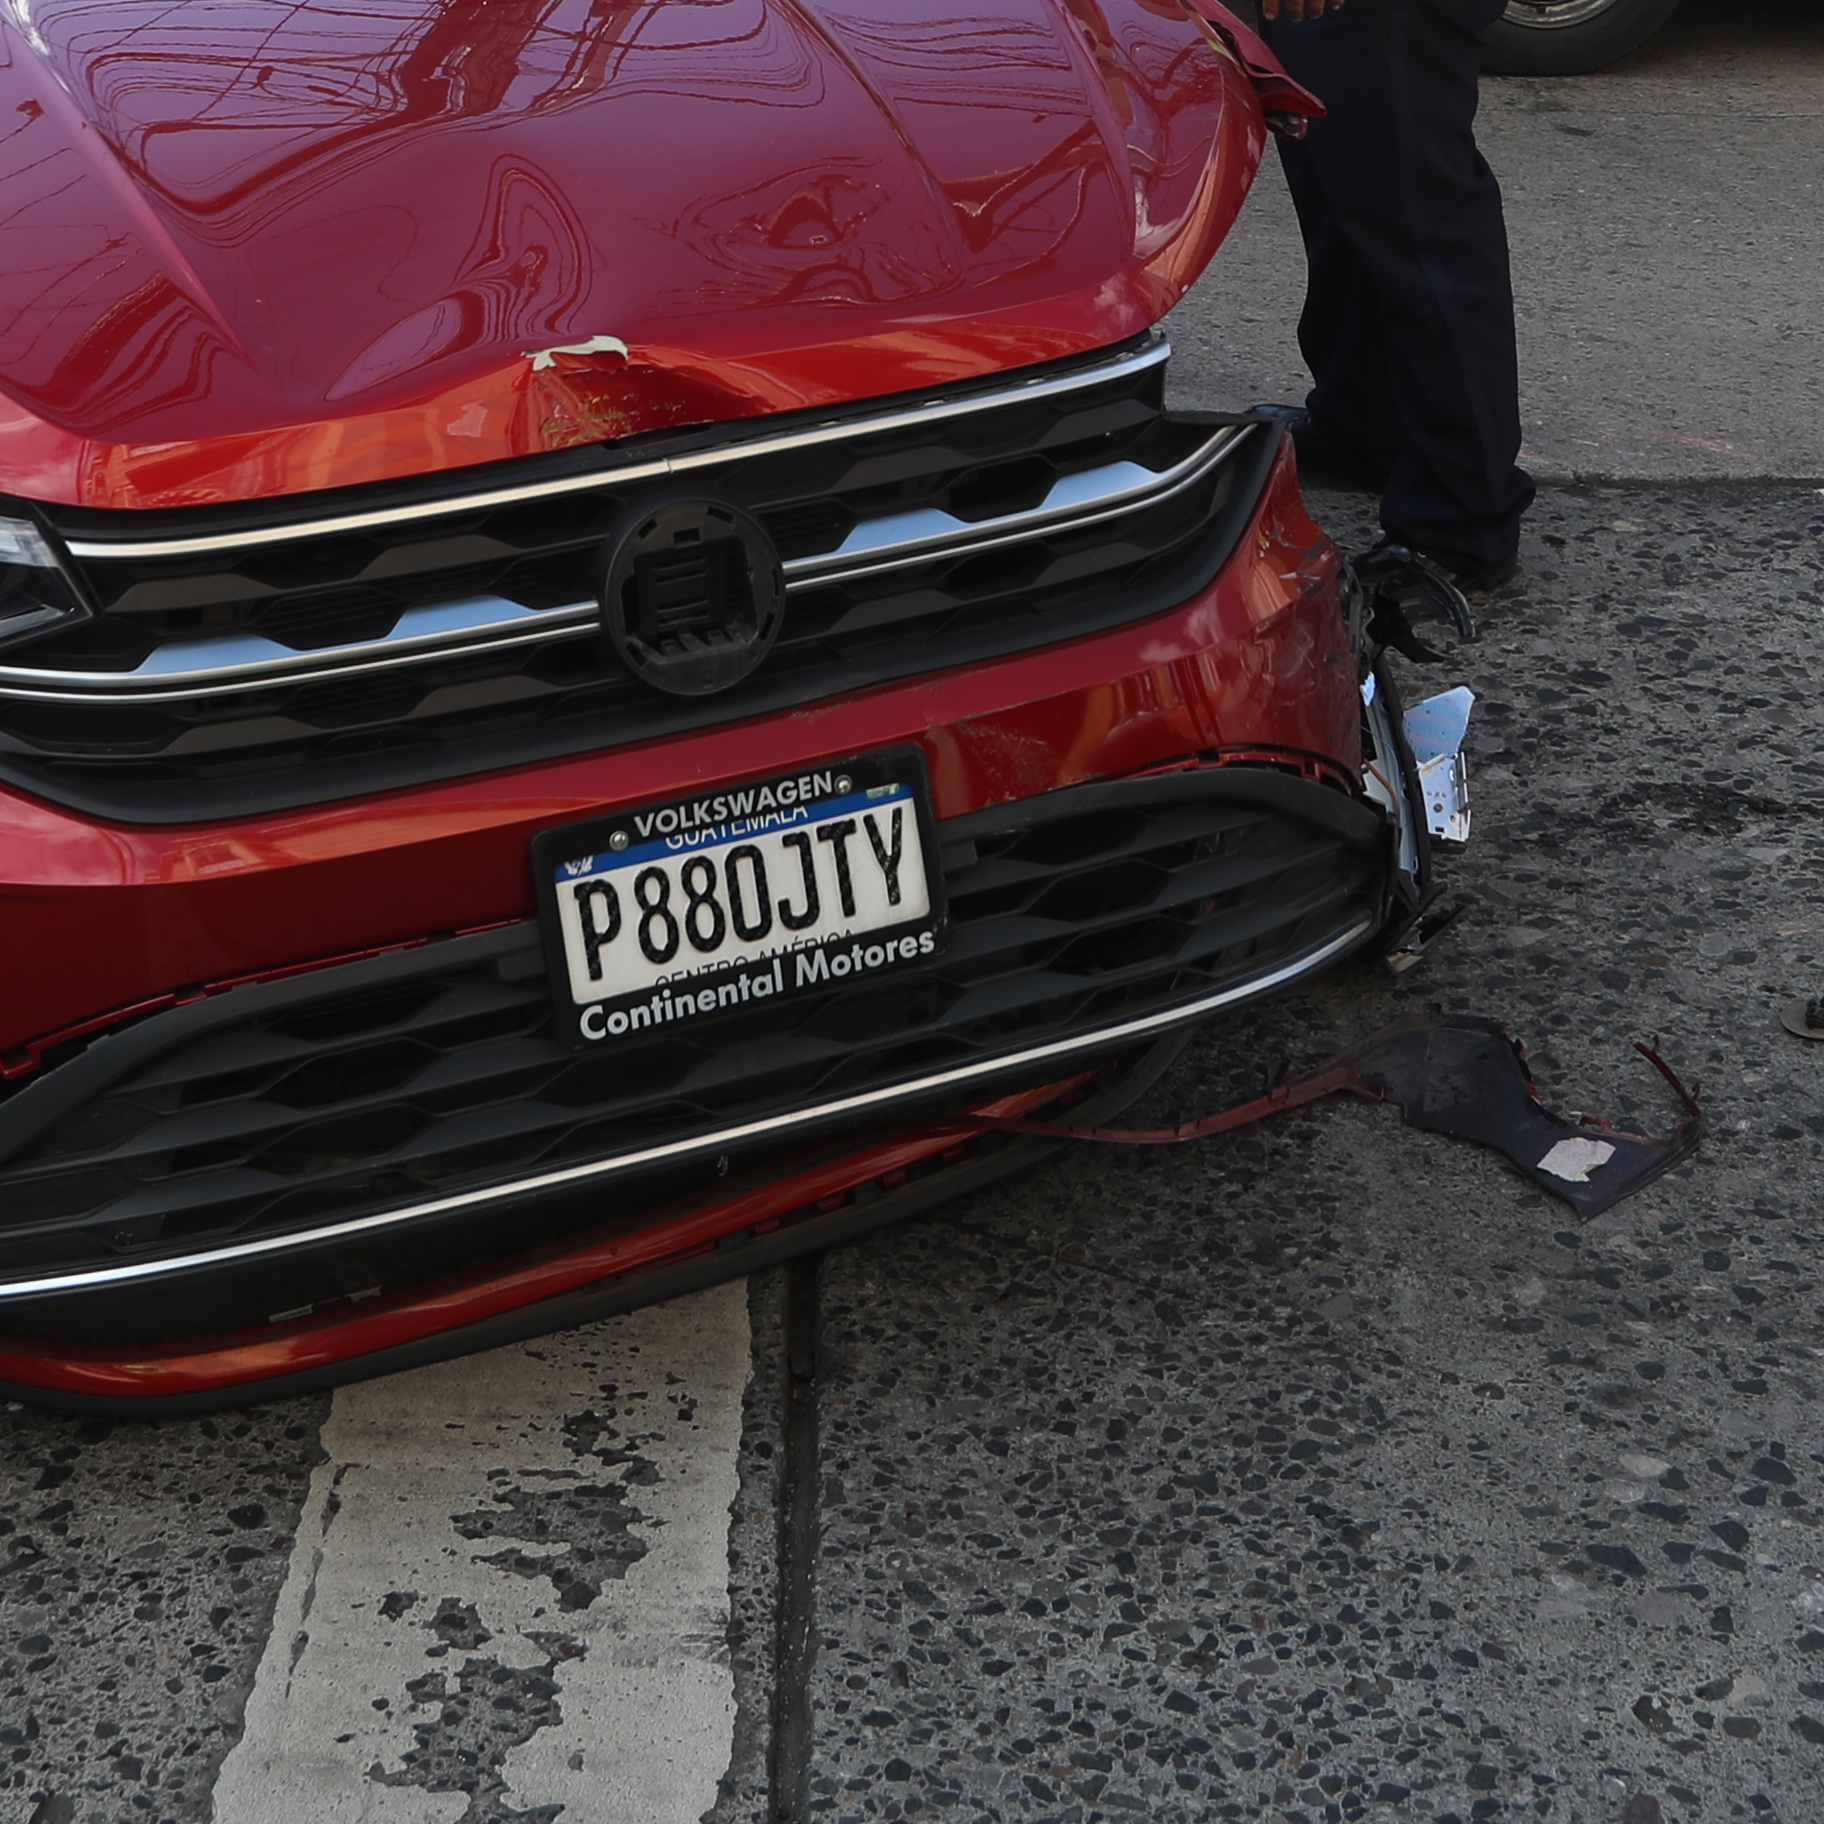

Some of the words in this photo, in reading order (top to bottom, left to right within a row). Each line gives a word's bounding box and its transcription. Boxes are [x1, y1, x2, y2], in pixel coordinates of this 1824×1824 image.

[633, 770, 833, 838] VOLKSWAGEN
[579, 958, 784, 1041] Continental
[795, 930, 936, 988] Motores
